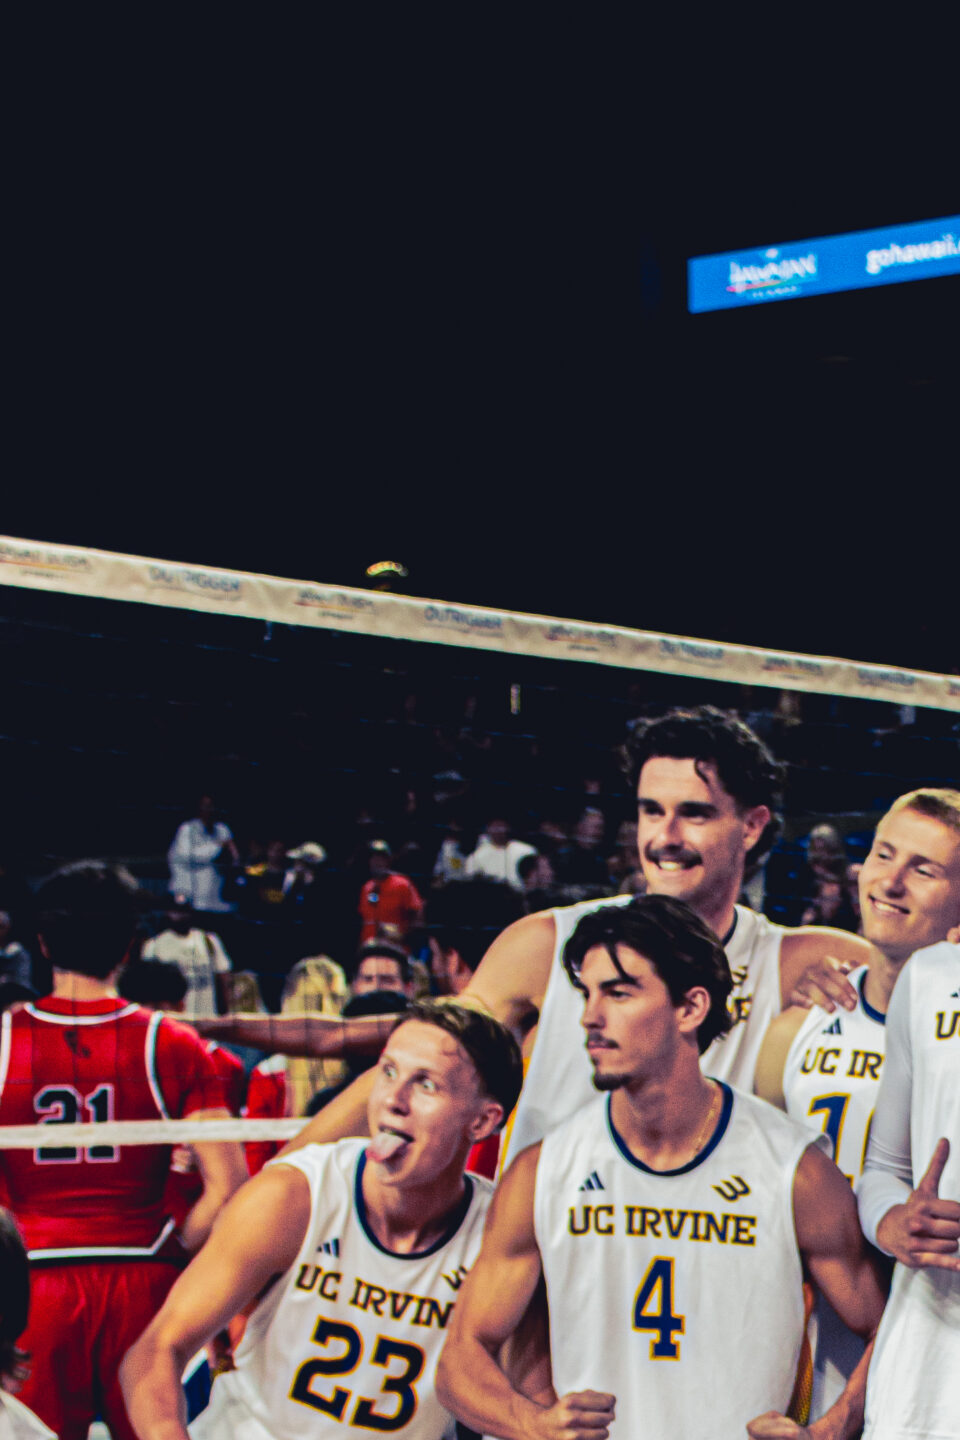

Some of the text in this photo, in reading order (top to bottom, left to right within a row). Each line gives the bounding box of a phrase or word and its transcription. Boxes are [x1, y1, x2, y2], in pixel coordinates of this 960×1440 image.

[800, 1046, 841, 1076] UC
[34, 1084, 121, 1165] 21
[568, 1206, 757, 1247] UC IRVINE
[295, 1263, 343, 1302] UC
[632, 1256, 685, 1361] 4
[288, 1315, 427, 1434] 23
